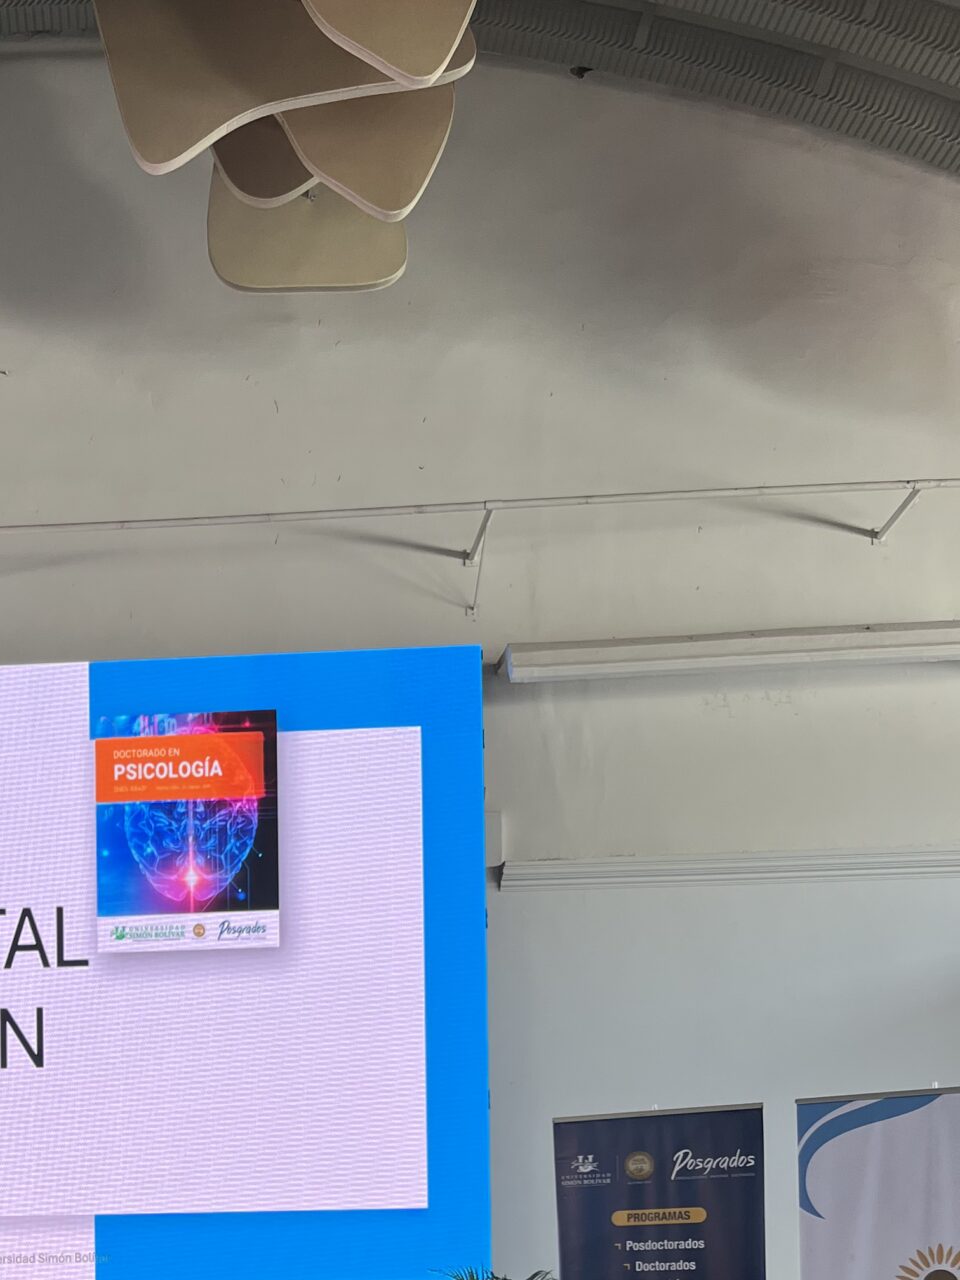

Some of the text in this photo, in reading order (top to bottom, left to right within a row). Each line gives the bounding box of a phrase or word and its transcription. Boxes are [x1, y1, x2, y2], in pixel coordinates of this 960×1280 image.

[113, 747, 180, 759] DOCTORADO EN
[114, 756, 223, 781] PSICOLOGÍA
[218, 920, 266, 940] Posgrados
[671, 1149, 755, 1180] Posgrados
[627, 1211, 690, 1222] PROGRAMAS
[626, 1239, 705, 1251] Posdoctorados
[38, 1253, 72, 1265] Simón
[635, 1261, 696, 1271] Doctorados
